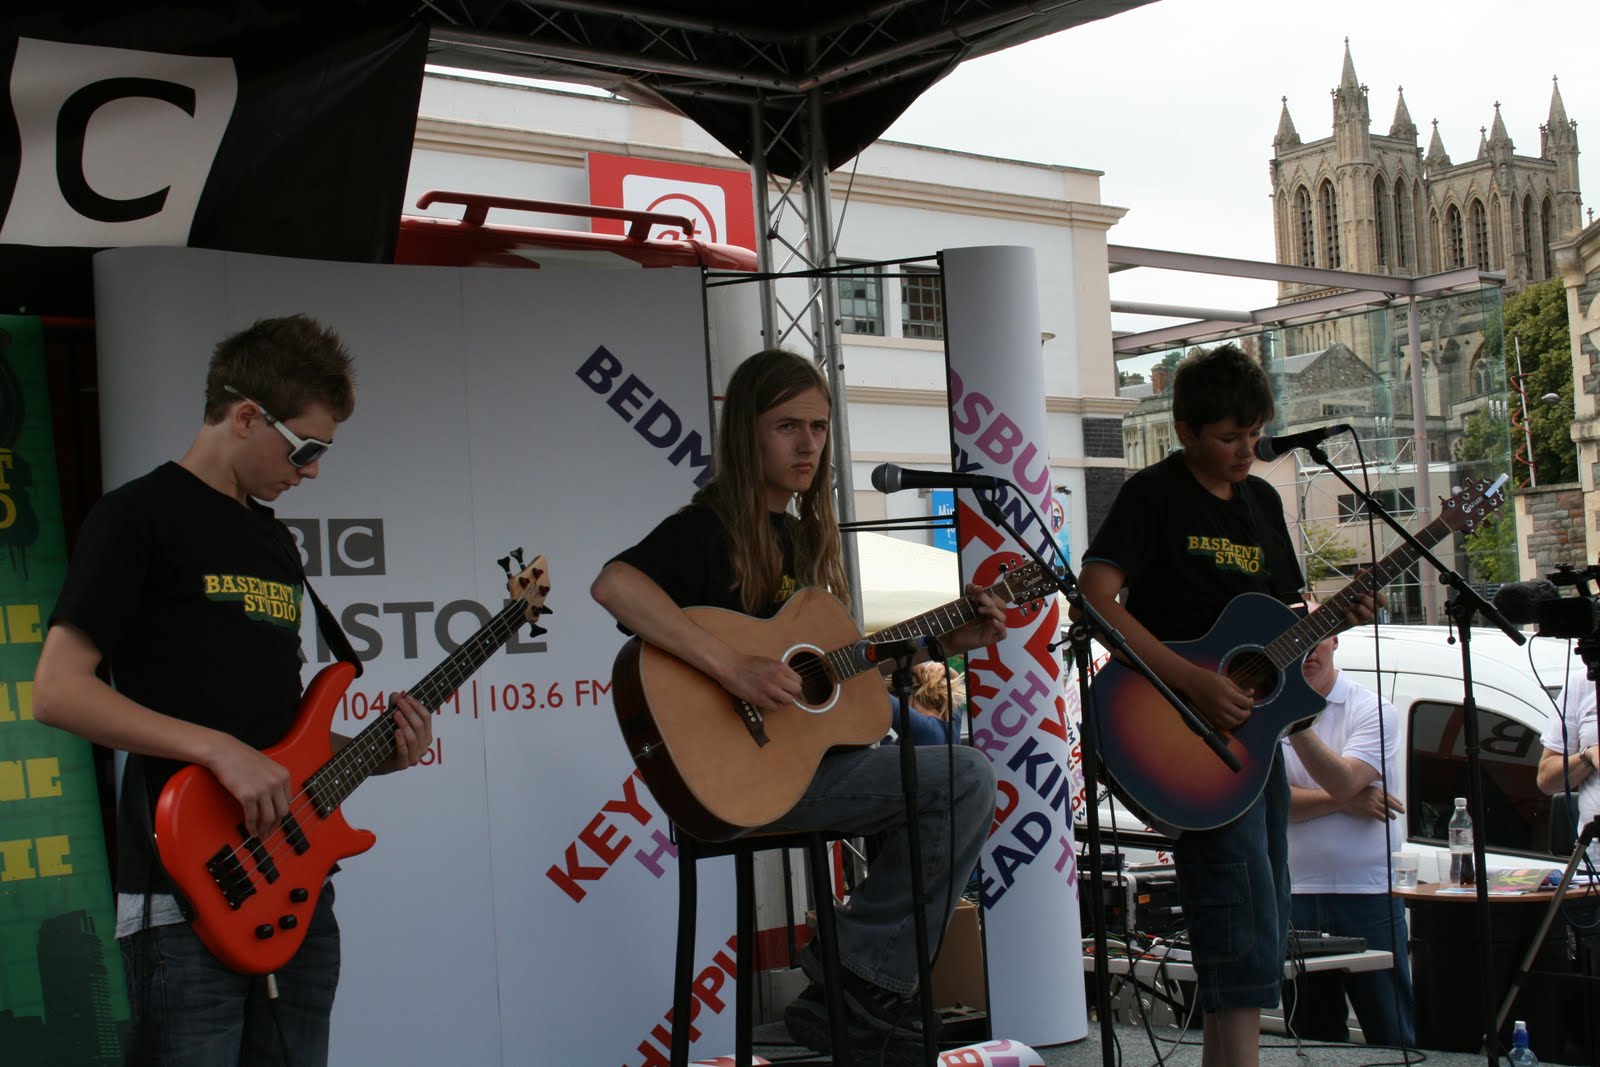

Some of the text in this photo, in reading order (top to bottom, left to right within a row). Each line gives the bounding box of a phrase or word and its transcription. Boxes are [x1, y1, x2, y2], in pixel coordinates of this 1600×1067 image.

[56, 77, 197, 223] C
[204, 575, 295, 603] BASEMENT
[244, 593, 297, 622] STUDIO
[297, 599, 548, 664] ISTOL
[491, 682, 564, 712] 103.6
[545, 766, 653, 904] KEY
[621, 934, 738, 1067] HIPPI
